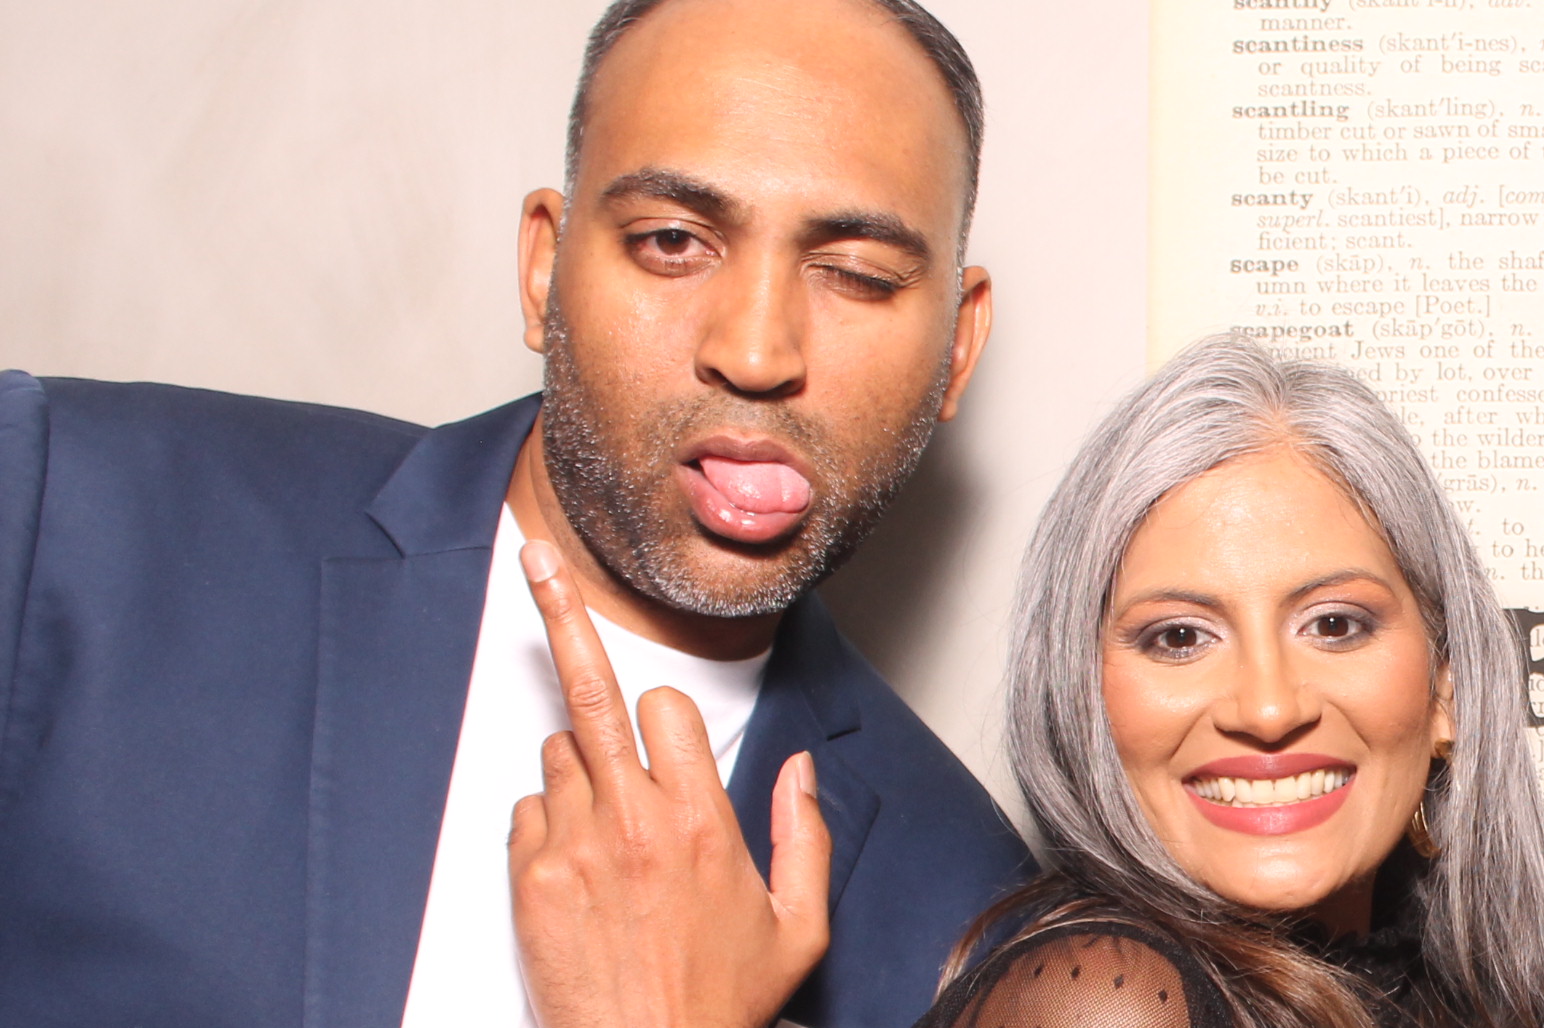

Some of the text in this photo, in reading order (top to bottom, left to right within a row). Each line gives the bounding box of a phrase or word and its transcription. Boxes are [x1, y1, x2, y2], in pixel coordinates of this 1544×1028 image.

[1259, 17, 1353, 31] manner.
[1232, 35, 1364, 54] scantiness
[1258, 61, 1282, 75] or
[1300, 55, 1382, 78] quality
[1400, 55, 1423, 73] of
[1441, 54, 1501, 76] being
[1258, 82, 1372, 97] scantness.
[1232, 100, 1350, 121] scantling
[1520, 105, 1542, 117] n.
[1258, 121, 1334, 141] timber
[1340, 124, 1375, 140] cut
[1383, 127, 1407, 139] or
[1413, 126, 1471, 139] sawn
[1479, 122, 1498, 139] of
[1257, 144, 1297, 161] size
[1309, 146, 1330, 161] to
[1343, 142, 1408, 161] which
[1419, 149, 1432, 161] a
[1442, 144, 1500, 164] piece
[1509, 142, 1532, 160] of
[1259, 166, 1337, 185] be cut.
[1231, 191, 1313, 209] scanty
[1443, 187, 1485, 208] adj.
[1256, 210, 1330, 232] superl.
[1337, 209, 1450, 230] scantiest],
[1258, 232, 1412, 251] ficient; scant.
[1230, 258, 1298, 274] scape
[1408, 257, 1430, 270] n.
[1449, 252, 1484, 270] the
[1256, 279, 1306, 294] umn
[1317, 274, 1384, 293] where
[1395, 274, 1411, 293] it
[1422, 274, 1490, 293] leaves
[1502, 274, 1537, 293] the
[1255, 295, 1490, 320] v.i. to escape [Poet.]
[1230, 320, 1354, 340] scapegoat
[1511, 324, 1532, 337] n.
[1269, 341, 1337, 360] ncient
[1351, 341, 1406, 360] Jews
[1419, 345, 1460, 359] one
[1473, 340, 1496, 359] of
[1396, 362, 1424, 383] by
[1438, 362, 1473, 381] lot,
[1483, 367, 1535, 381] over
[1376, 384, 1438, 406] priest
[1444, 406, 1498, 425] after
[1433, 429, 1467, 447] the
[1430, 450, 1466, 469] the
[1516, 479, 1538, 491] n.
[1502, 518, 1525, 536] to
[1492, 541, 1514, 558] to
